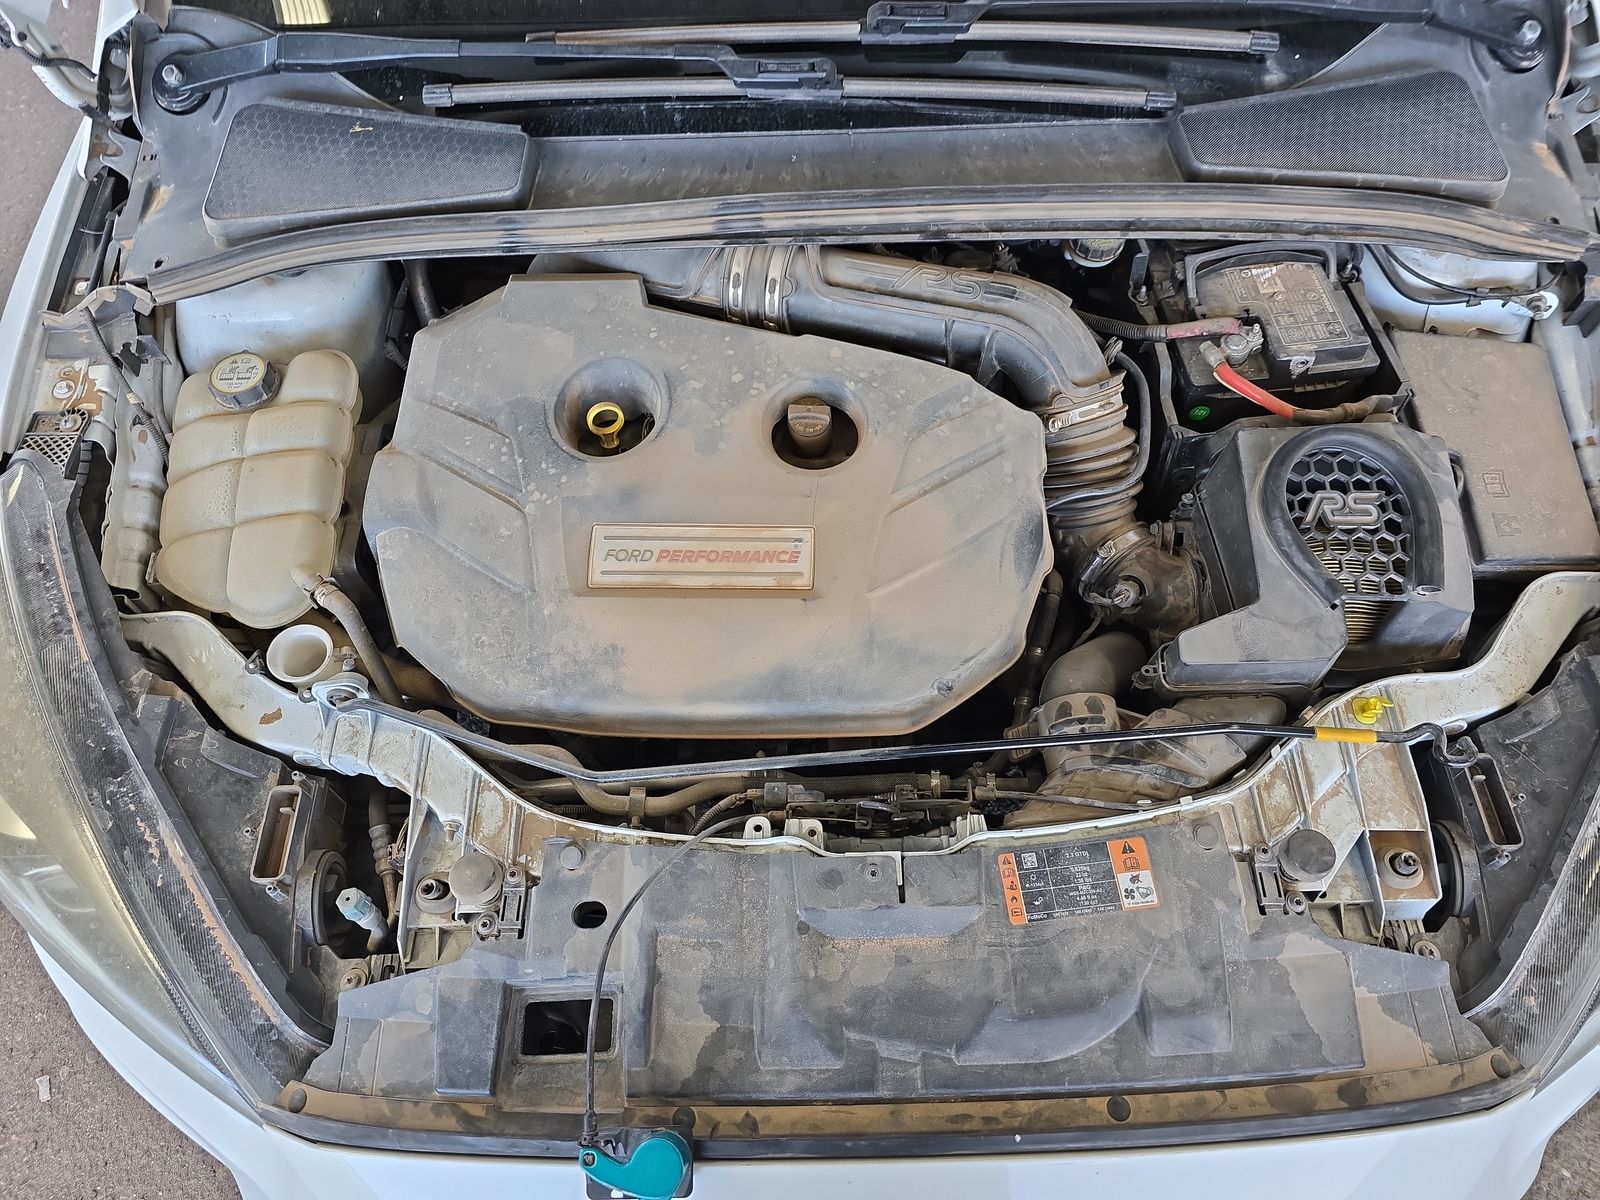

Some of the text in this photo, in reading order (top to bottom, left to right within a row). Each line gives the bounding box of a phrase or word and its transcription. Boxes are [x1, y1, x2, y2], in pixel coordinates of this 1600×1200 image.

[1300, 490, 1385, 528] RS
[603, 548, 801, 565] FORD PERFORMANCE
